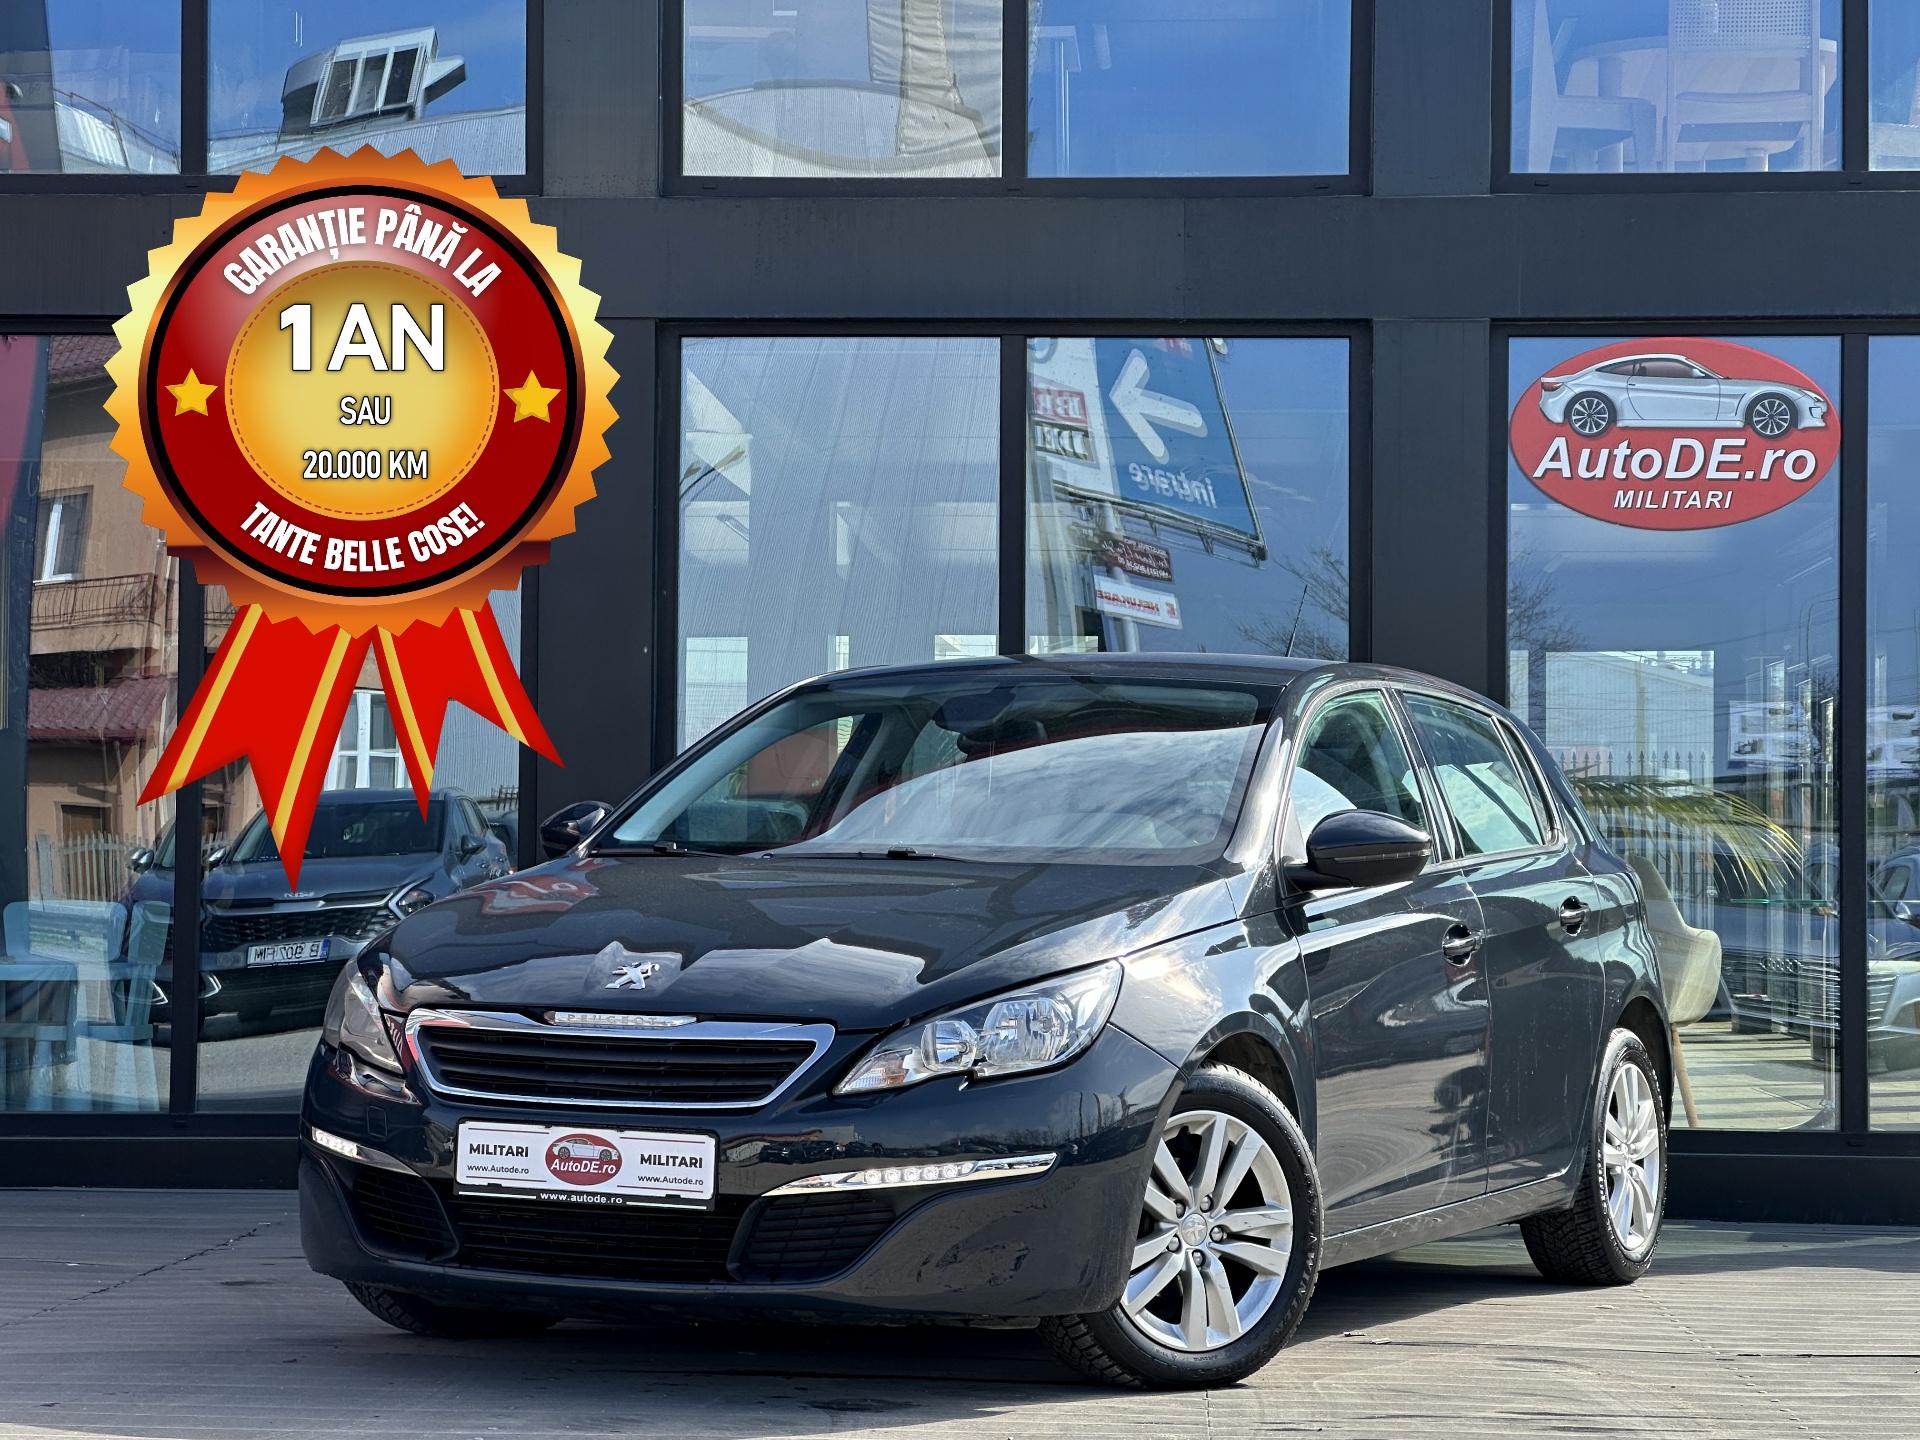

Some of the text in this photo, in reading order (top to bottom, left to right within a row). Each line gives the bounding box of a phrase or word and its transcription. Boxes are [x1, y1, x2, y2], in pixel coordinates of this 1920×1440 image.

[1532, 436, 1817, 481] AutoDE.ro
[1613, 489, 1733, 510] MILITARI
[567, 1013, 657, 1026] PEUGEOT
[469, 1143, 529, 1158] MILITARI
[550, 1158, 617, 1174] AutoDE.ro
[640, 1153, 703, 1169] MILITARI
[467, 1164, 530, 1175] www.Autode.ro
[637, 1175, 704, 1186] www.Autode.ro
[539, 1192, 623, 1205] www.autode.ro
